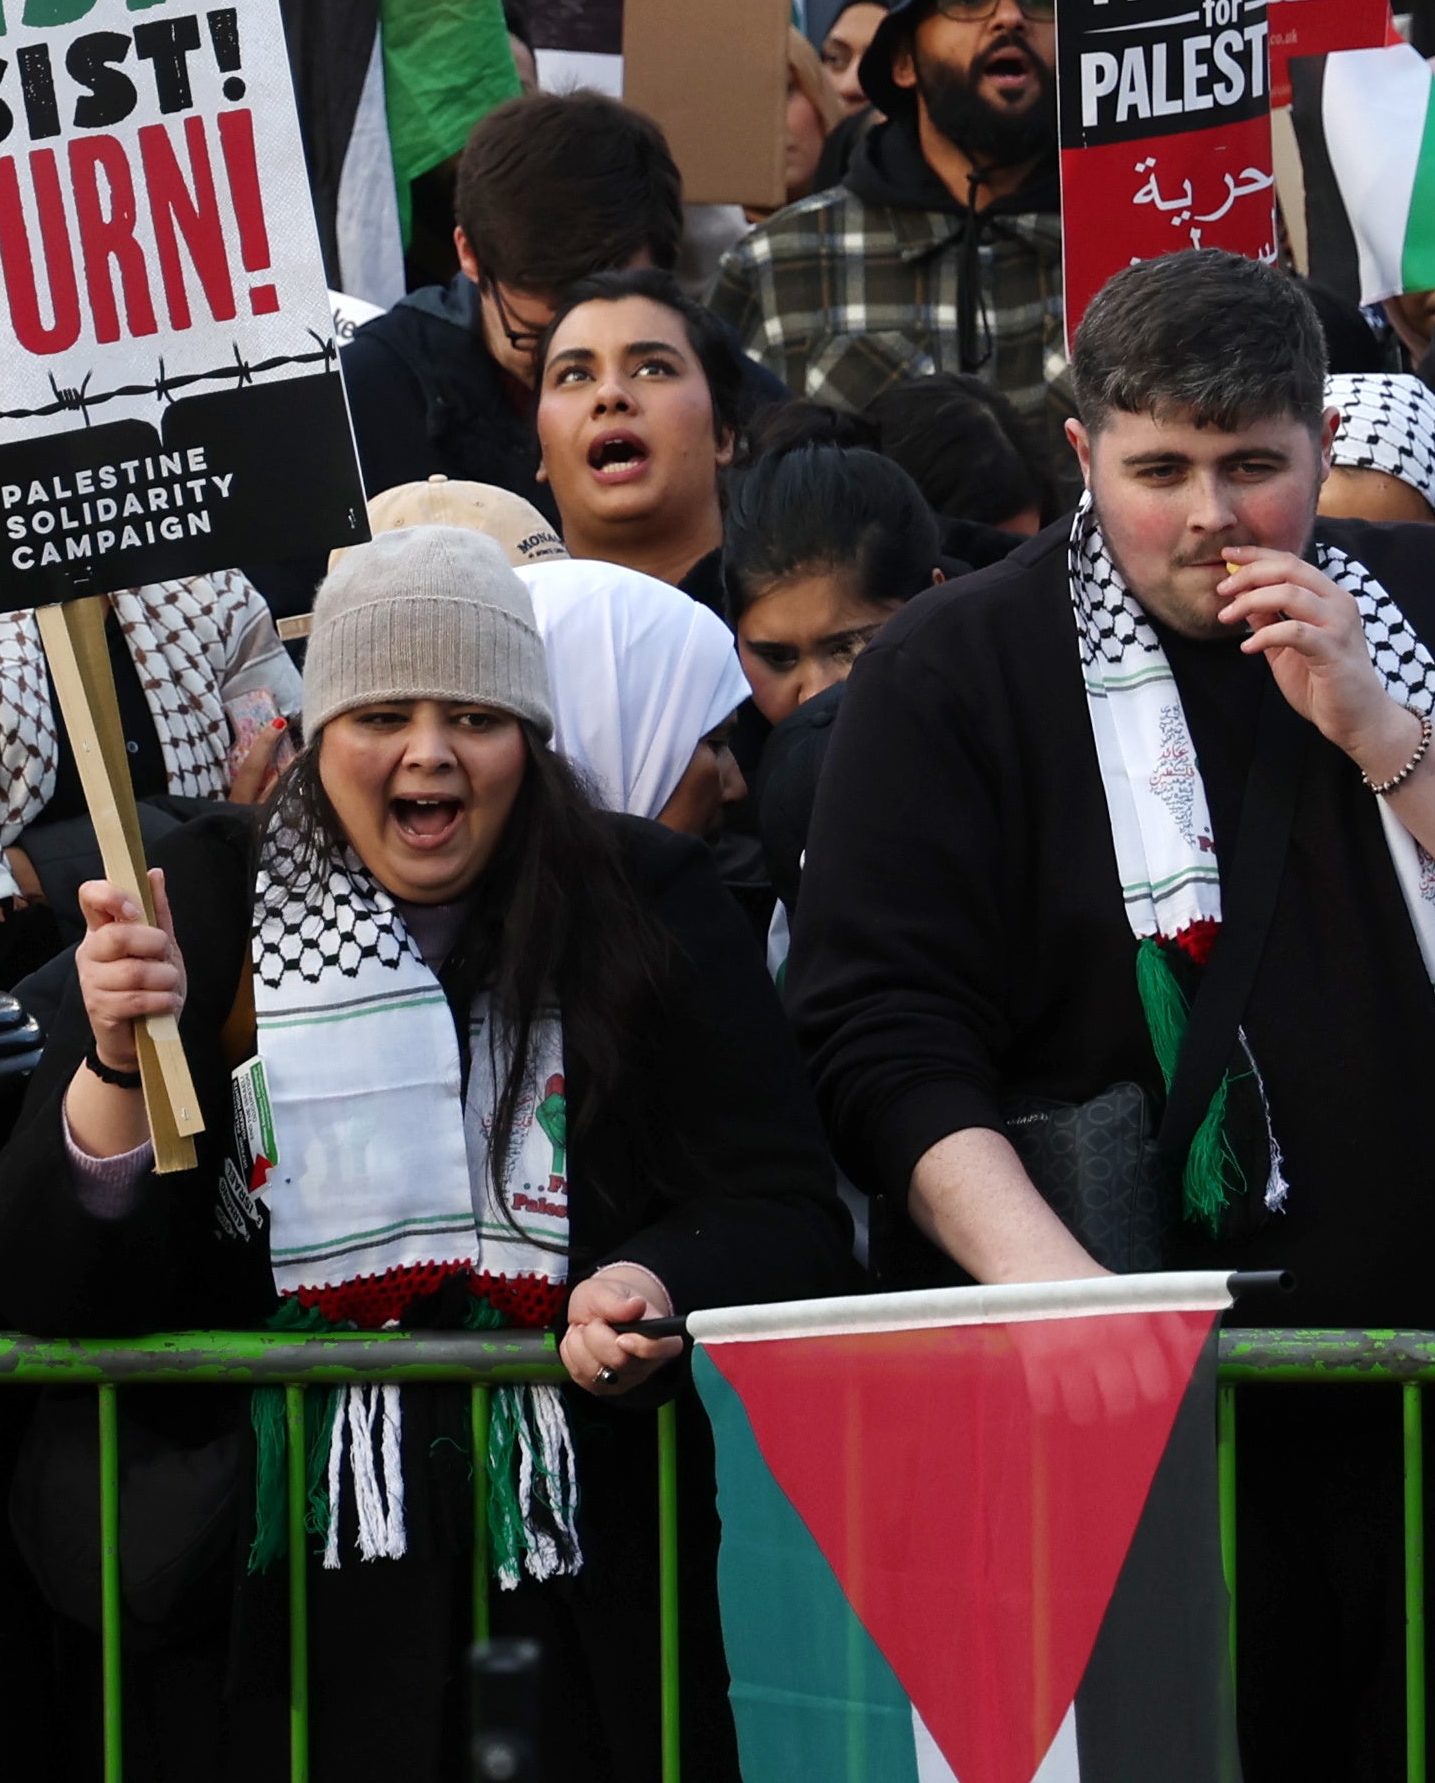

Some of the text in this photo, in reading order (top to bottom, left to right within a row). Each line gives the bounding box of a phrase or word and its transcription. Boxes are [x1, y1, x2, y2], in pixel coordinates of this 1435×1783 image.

[1080, 19, 1269, 127] PALEST
[0, 446, 209, 509] PALESTINE
[6, 473, 235, 541] SOLIDARITY
[11, 508, 212, 571] CAMPAIGN
